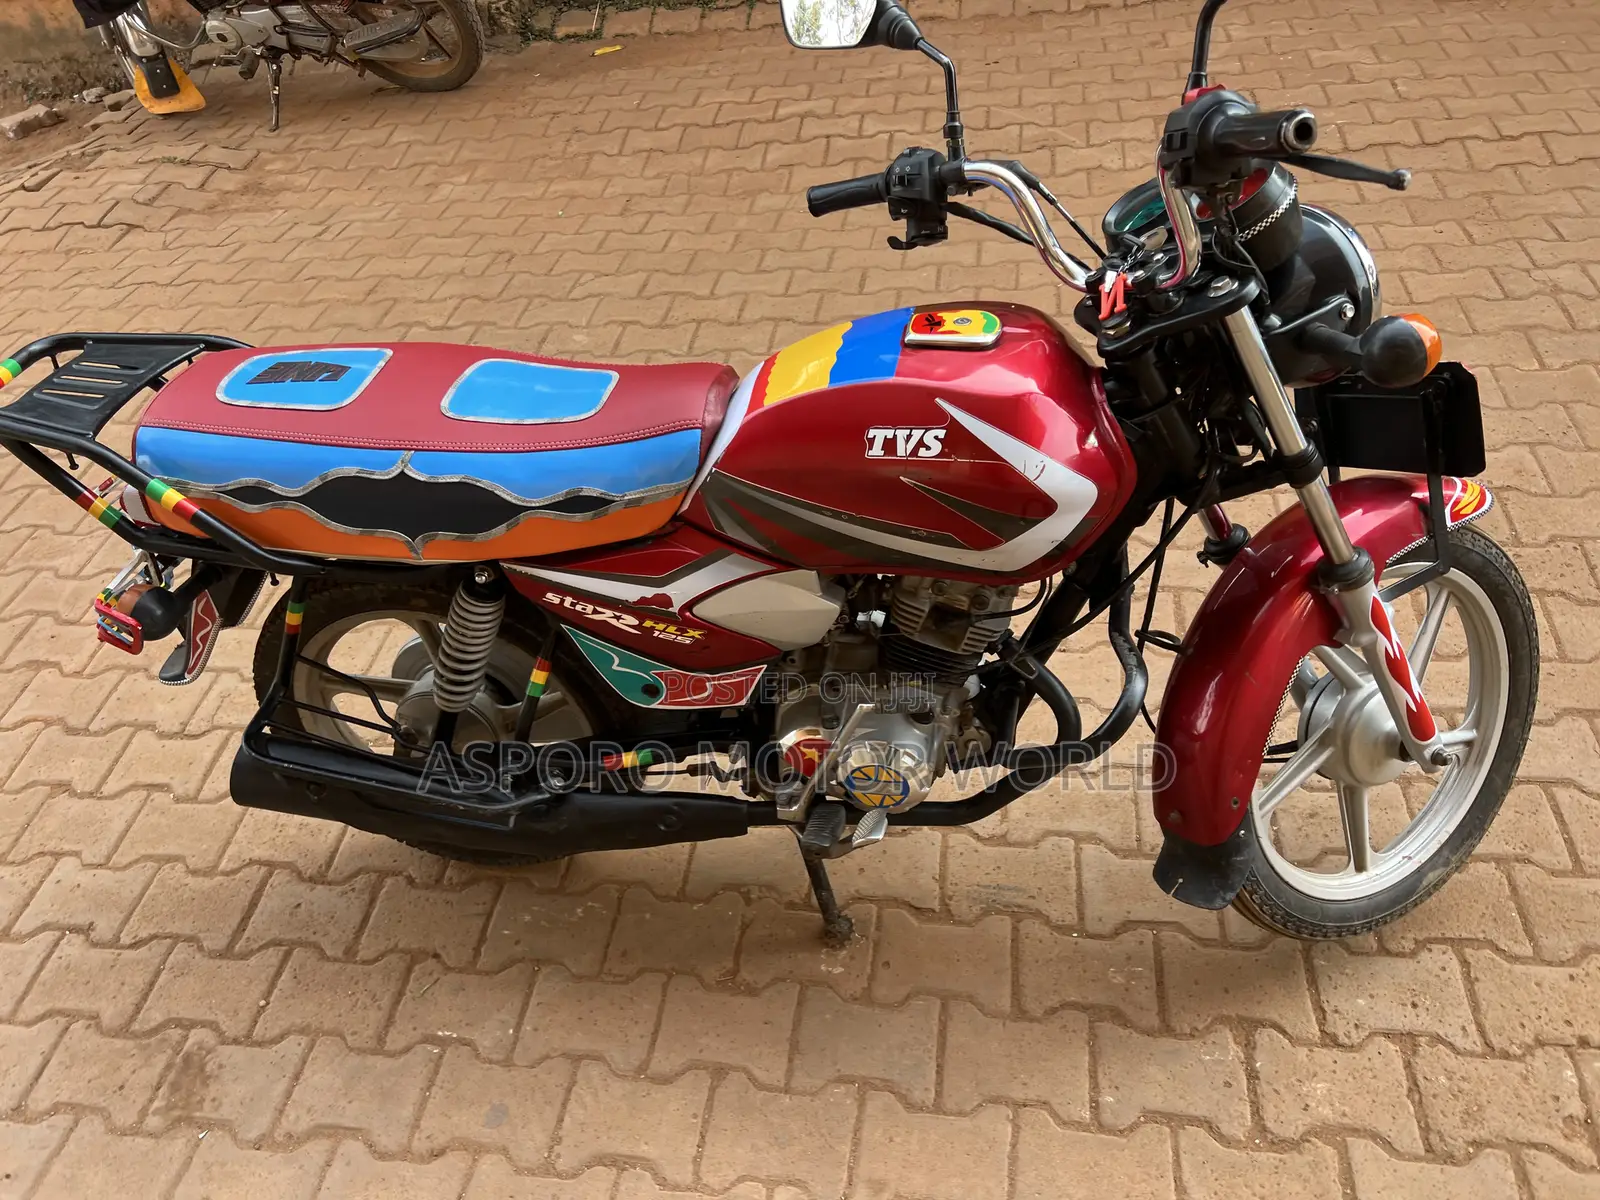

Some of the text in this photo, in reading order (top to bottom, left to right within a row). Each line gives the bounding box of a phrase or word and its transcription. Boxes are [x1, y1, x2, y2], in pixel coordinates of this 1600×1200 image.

[867, 428, 947, 457] TVS
[642, 619, 707, 640] HLX
[652, 630, 696, 645] 125
